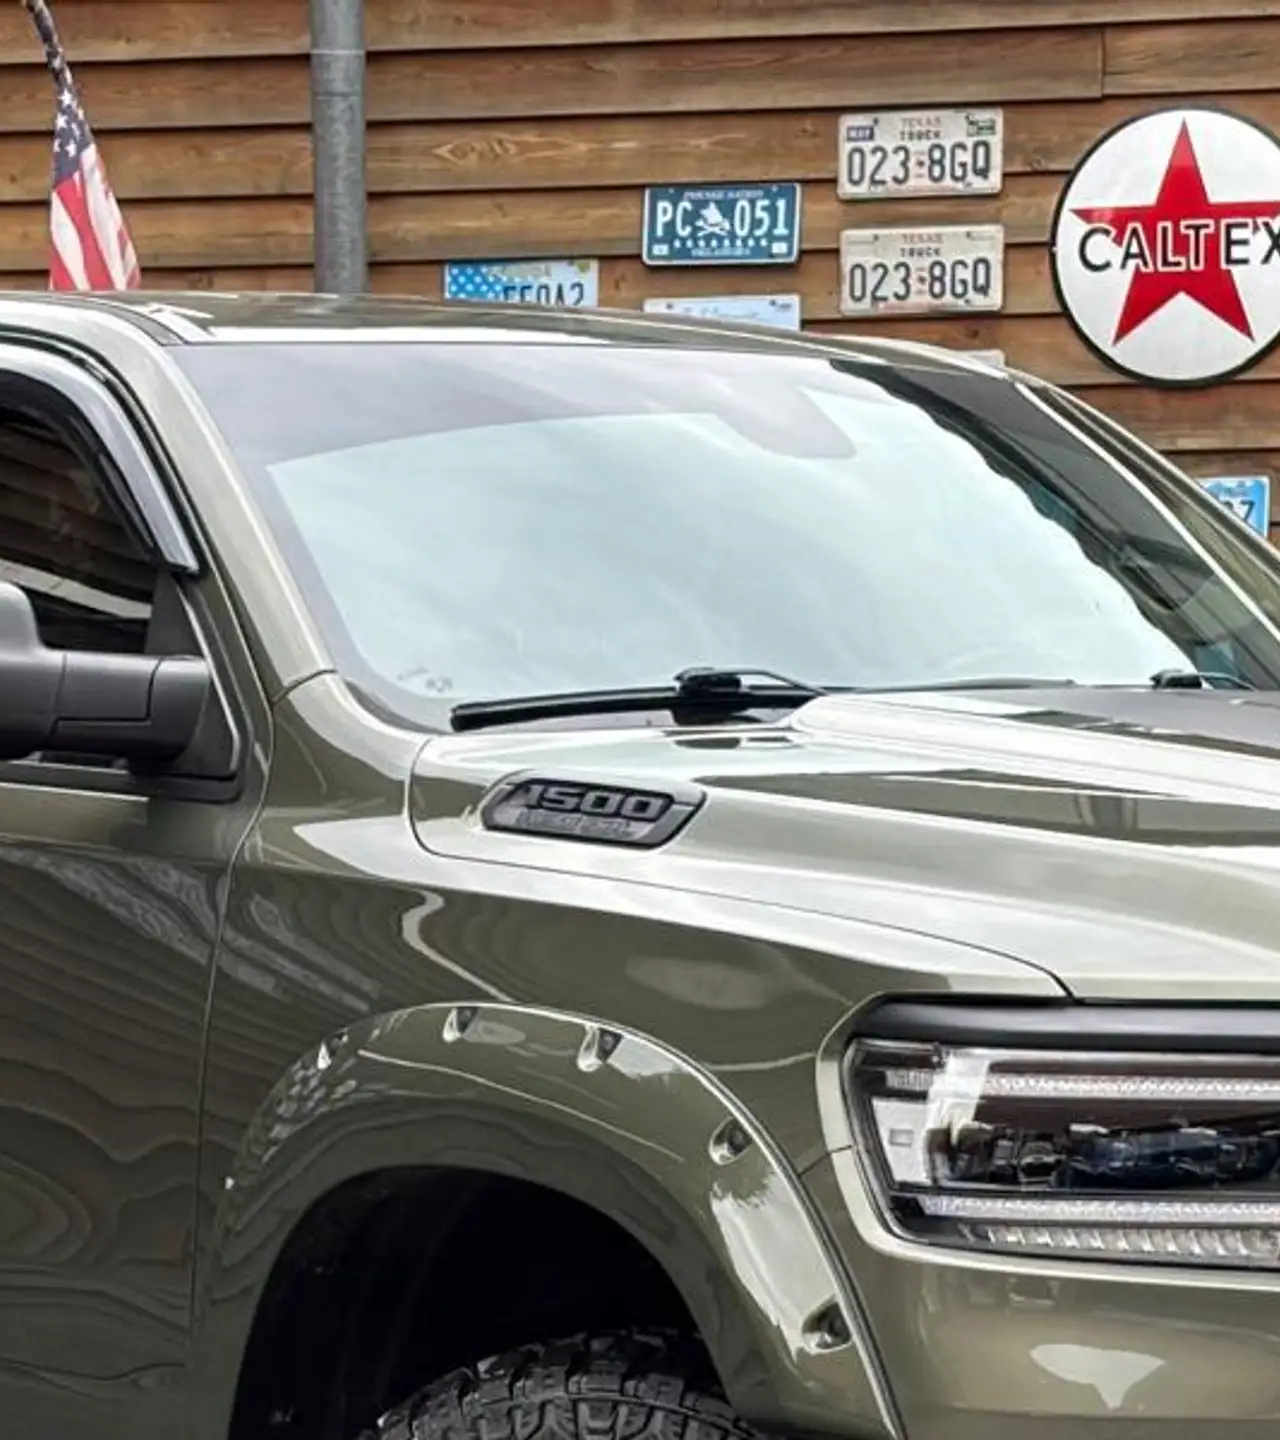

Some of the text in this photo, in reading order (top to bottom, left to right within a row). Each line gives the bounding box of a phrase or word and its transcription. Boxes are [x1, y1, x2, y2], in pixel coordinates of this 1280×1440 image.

[847, 139, 992, 187] 023 8GQ
[655, 197, 790, 238] PC 051
[848, 256, 992, 303] 023 8GQ
[521, 783, 666, 822] 1500
